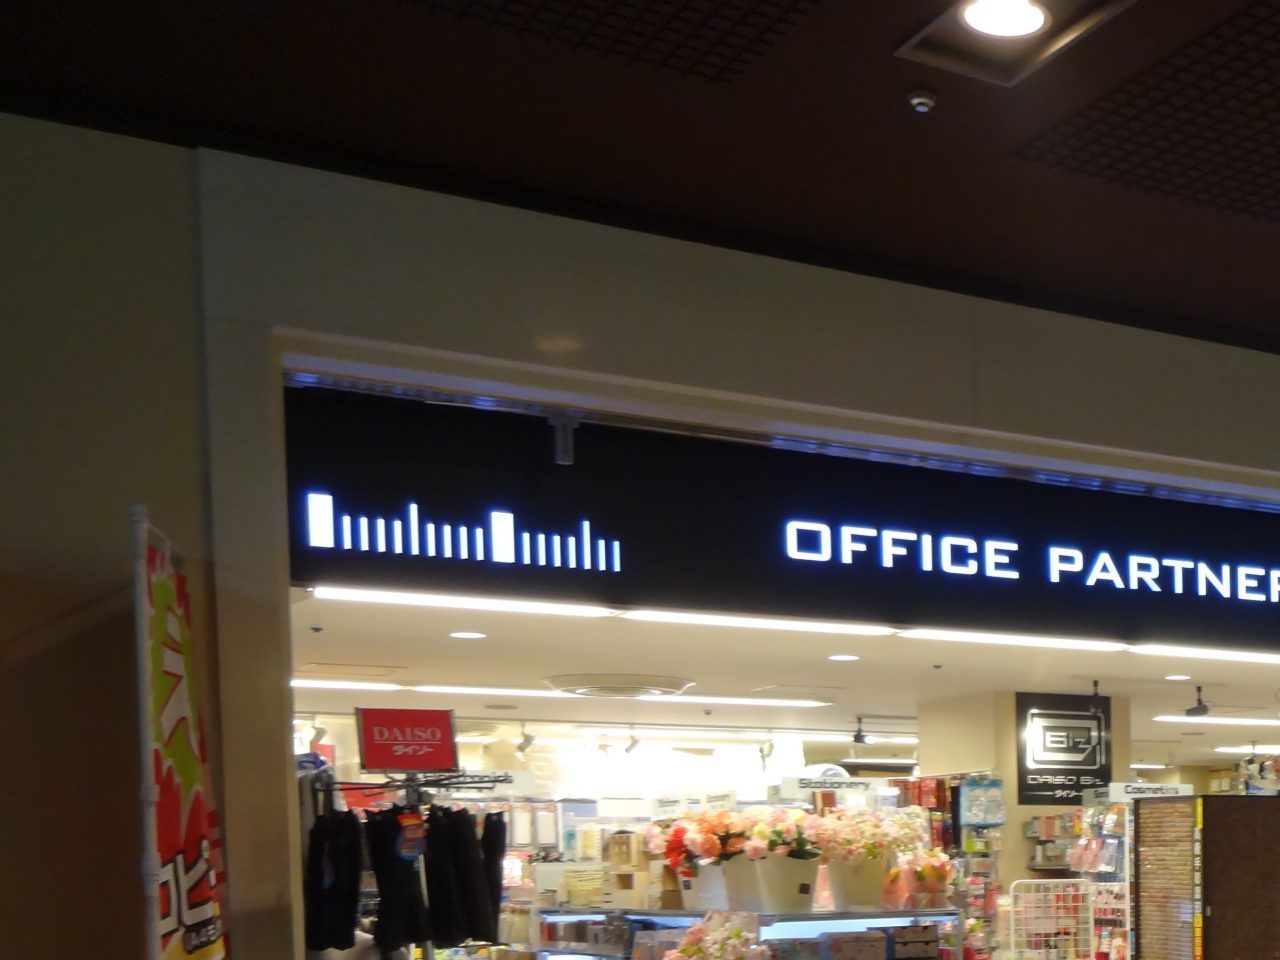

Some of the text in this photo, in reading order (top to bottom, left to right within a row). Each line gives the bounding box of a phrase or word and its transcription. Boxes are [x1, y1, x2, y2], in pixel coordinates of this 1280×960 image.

[784, 519, 1021, 580] OFFICE
[372, 726, 442, 742] DAISO
[1044, 731, 1091, 749] Biz
[798, 778, 870, 793] Stationery
[1027, 775, 1077, 786] DAISO
[1124, 784, 1179, 796] Cosmetics
